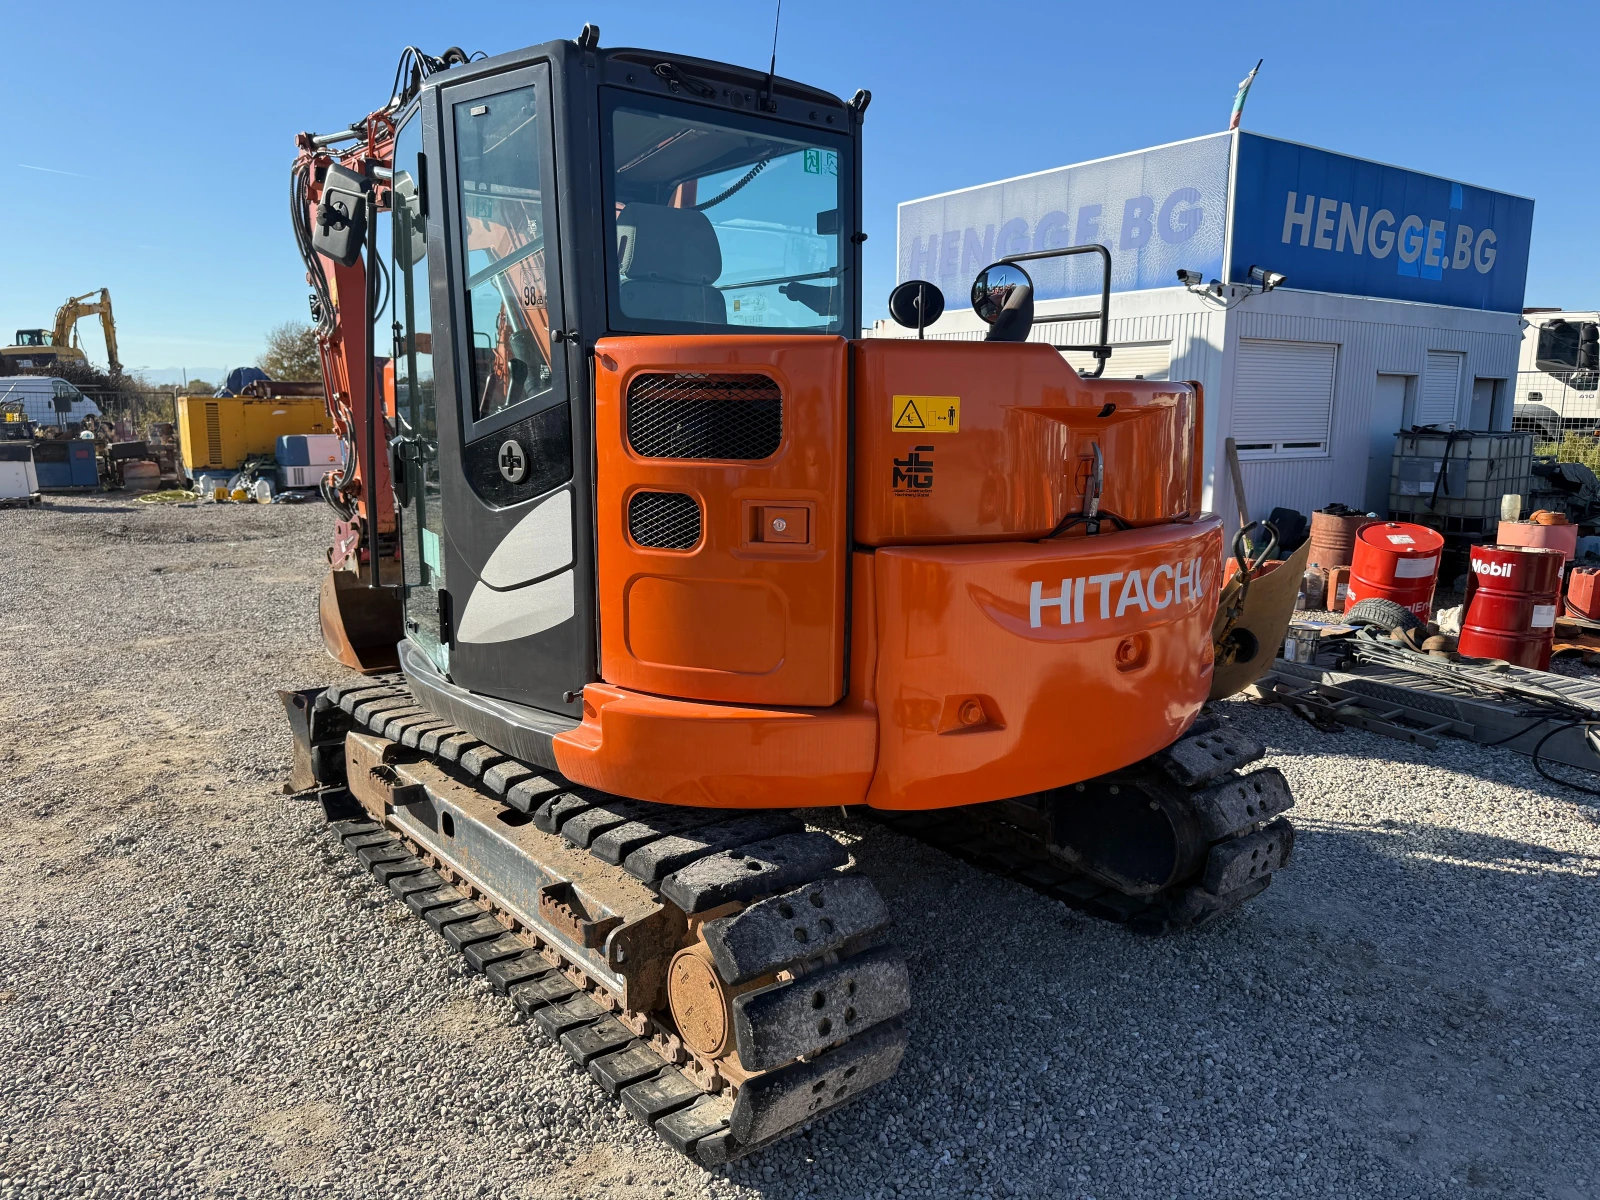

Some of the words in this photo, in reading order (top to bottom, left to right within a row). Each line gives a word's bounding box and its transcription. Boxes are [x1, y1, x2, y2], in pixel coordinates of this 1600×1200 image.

[910, 187, 1204, 279] HENGGE.BG
[1281, 191, 1498, 274] HENGGE.BG
[524, 286, 536, 306] 98
[1030, 557, 1203, 628] HITACHI
[1471, 558, 1512, 578] Mobil
